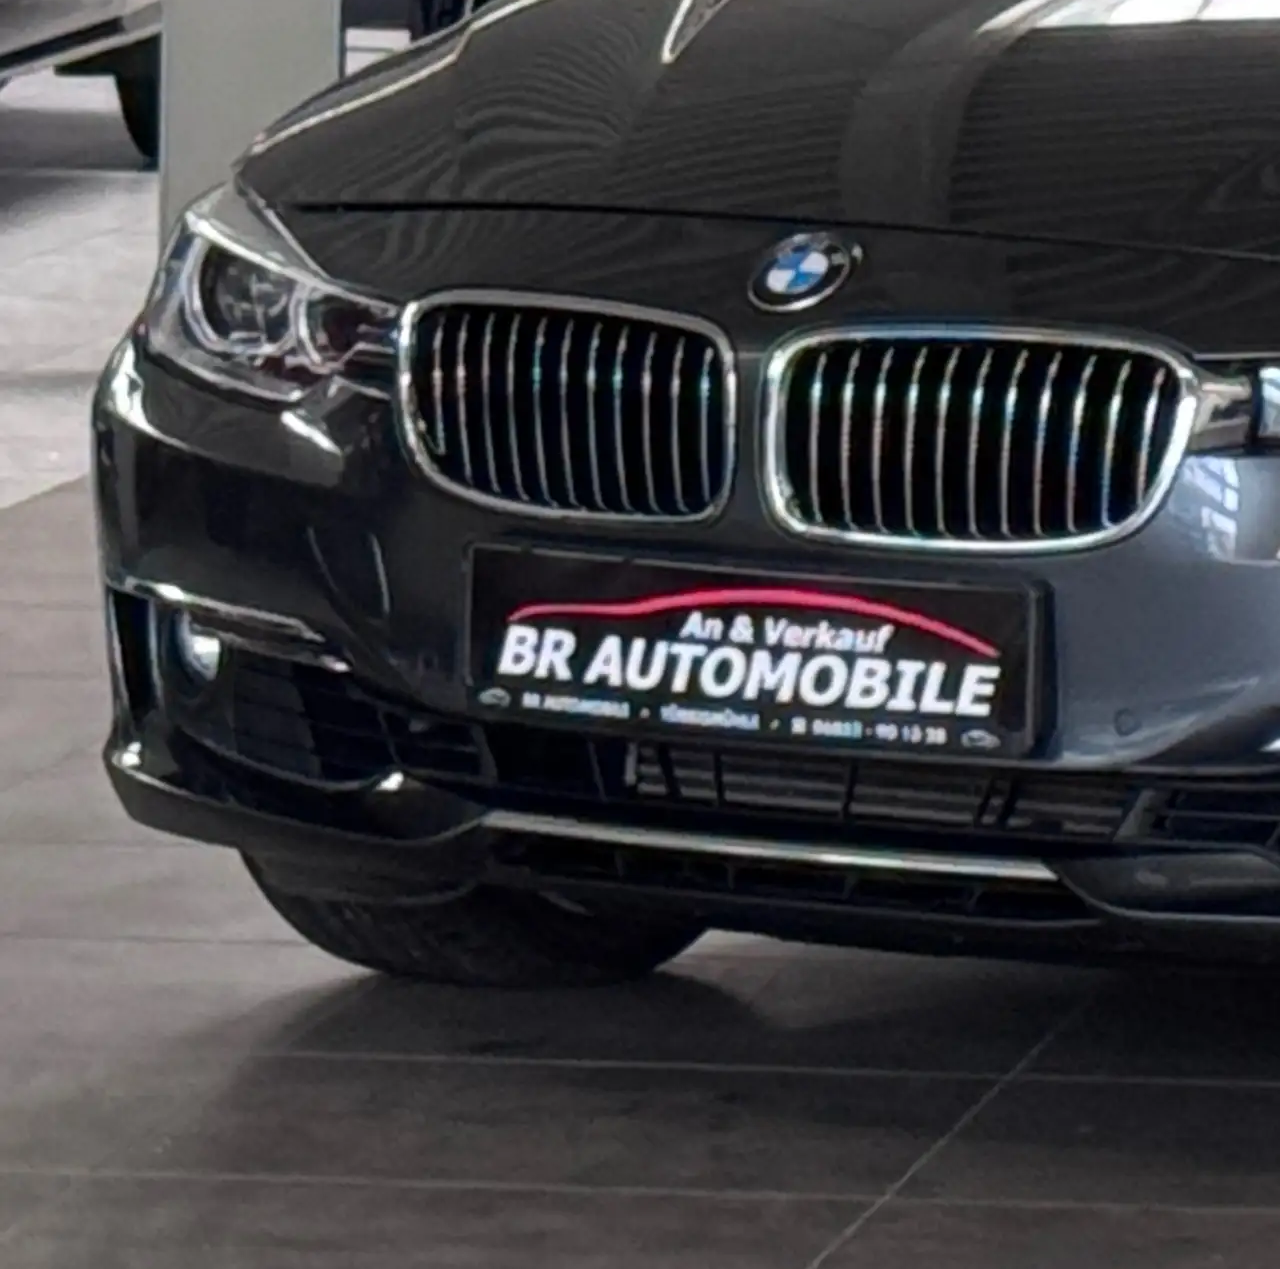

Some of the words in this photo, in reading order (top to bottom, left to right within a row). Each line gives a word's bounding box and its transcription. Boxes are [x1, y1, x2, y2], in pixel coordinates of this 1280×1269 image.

[679, 610, 724, 640] An
[728, 613, 754, 644] &
[764, 616, 895, 654] Verkauf
[498, 624, 577, 681] BR
[583, 634, 1001, 717] AUTOMOBILE
